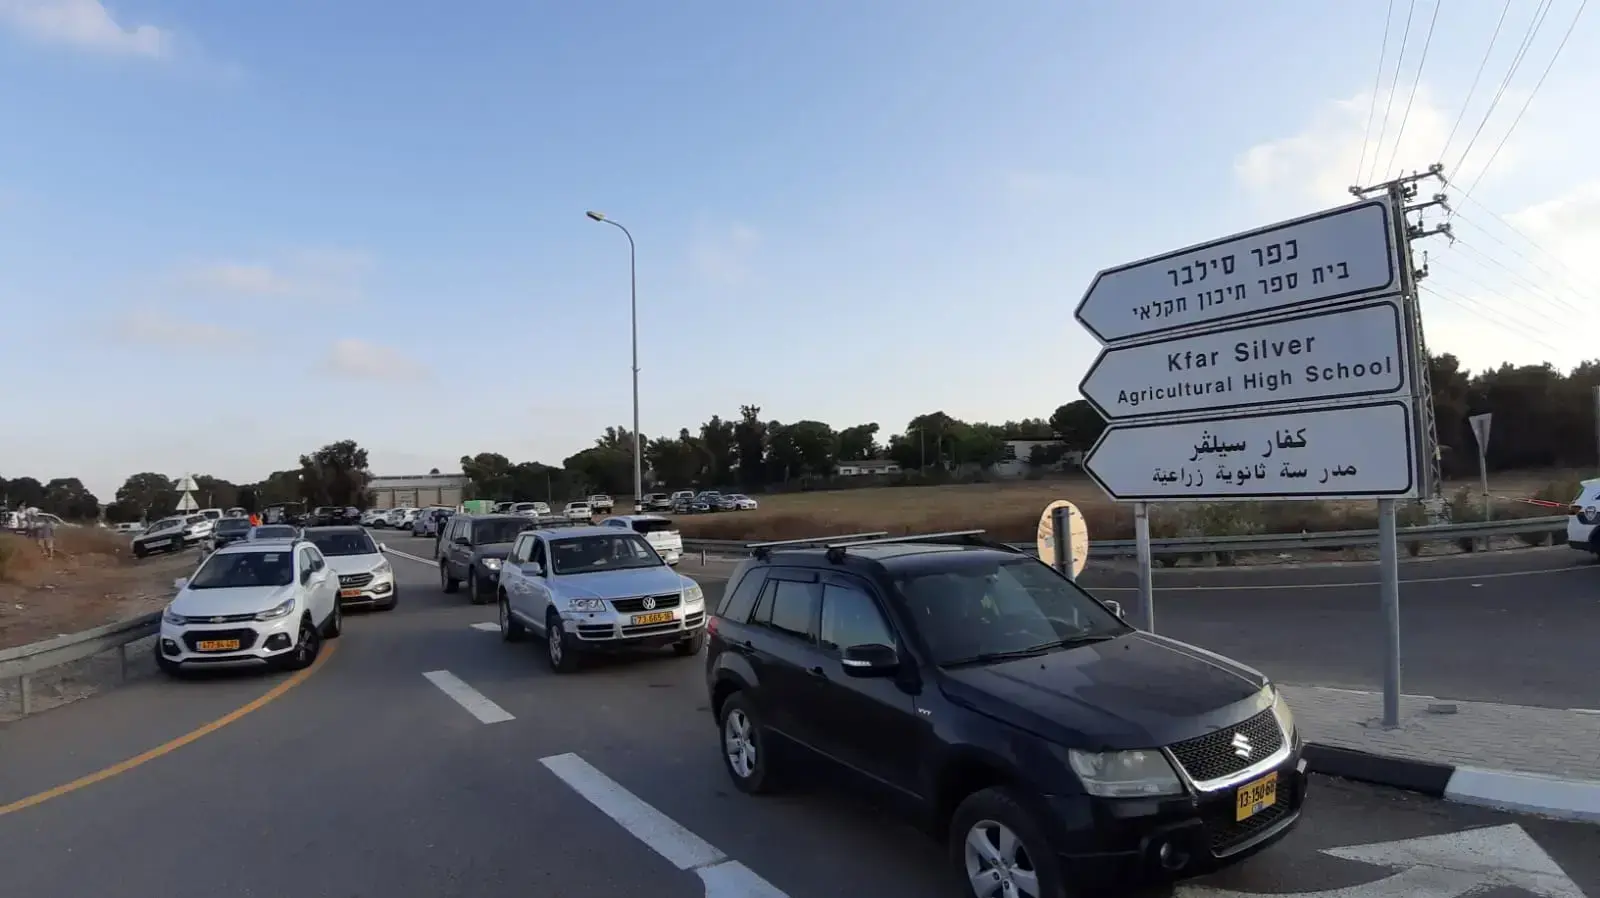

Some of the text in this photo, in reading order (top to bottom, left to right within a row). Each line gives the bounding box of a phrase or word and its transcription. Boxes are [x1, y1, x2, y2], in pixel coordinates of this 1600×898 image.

[1167, 239, 1298, 287] כפר סילבר
[1132, 261, 1350, 320] בית ספר תיכון חקלאי
[1168, 336, 1315, 372] Kfar Silver
[1118, 356, 1392, 406] Agricultural High School
[1262, 428, 1306, 457] كفار
[1152, 467, 1204, 487] زراعية
[1215, 463, 1266, 486] ثانوية
